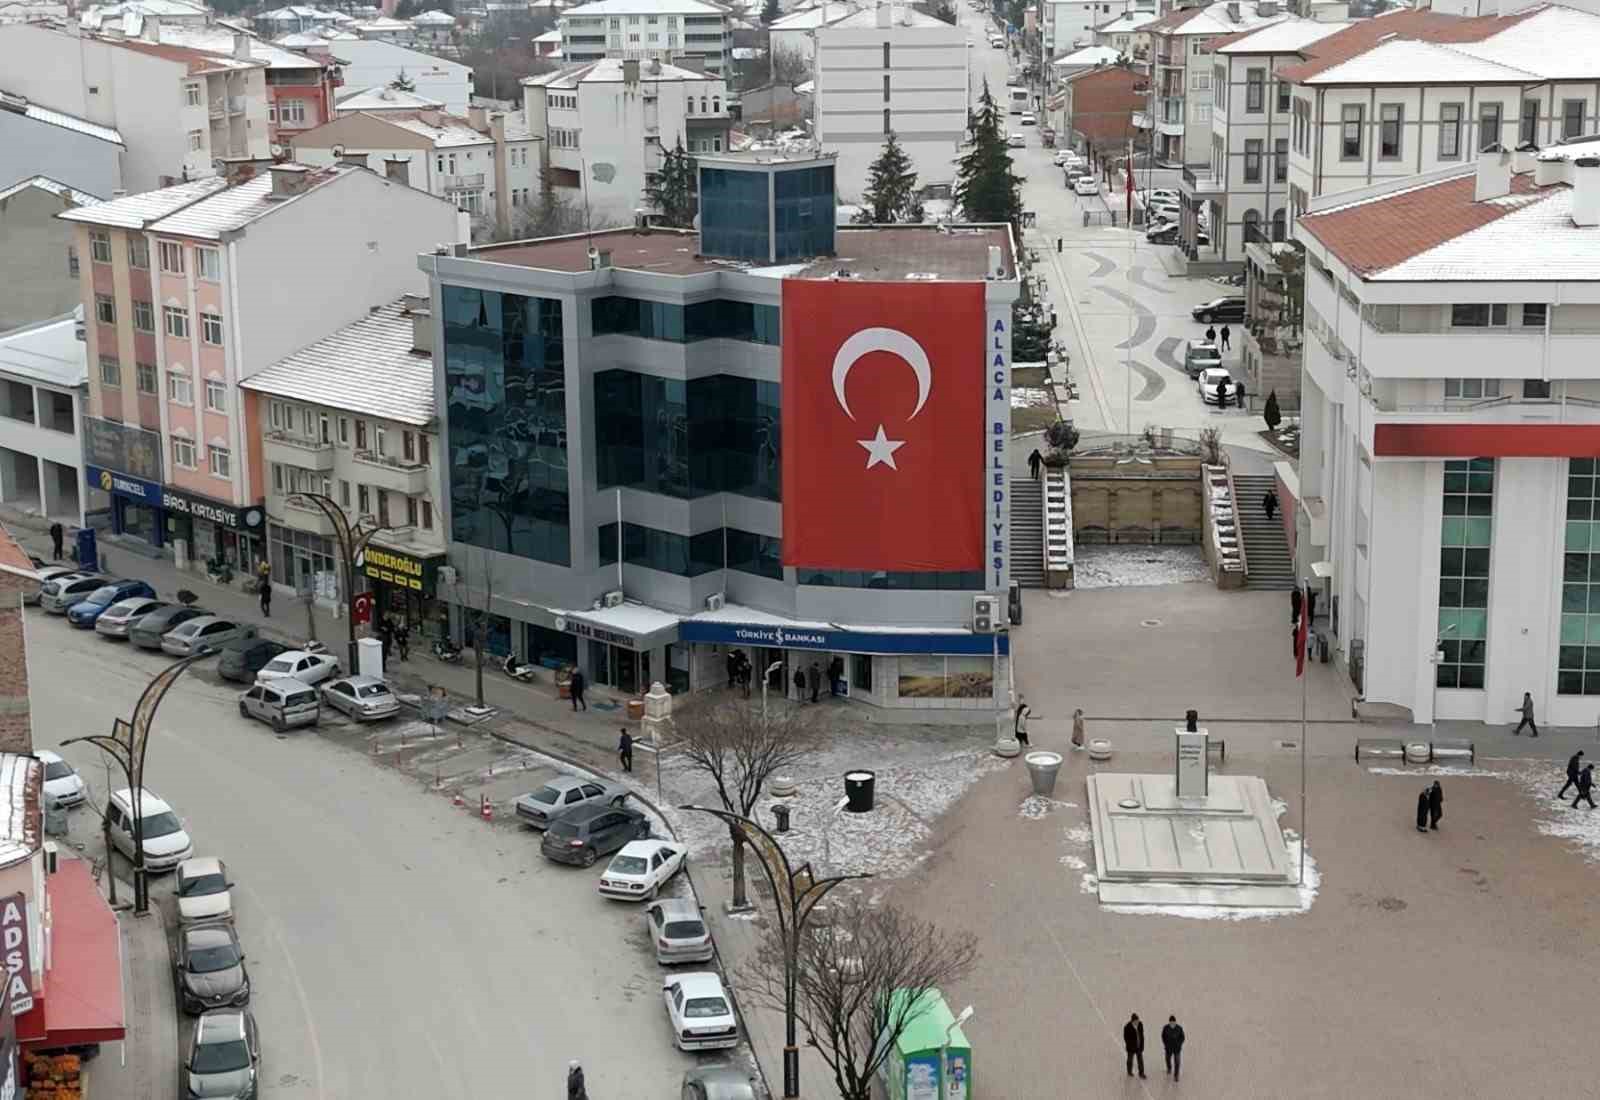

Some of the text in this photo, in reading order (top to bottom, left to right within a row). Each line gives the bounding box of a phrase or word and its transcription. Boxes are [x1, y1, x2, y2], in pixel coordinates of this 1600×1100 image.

[993, 319, 1005, 587] ALACA BELEDİYESİ
[113, 478, 146, 496] TURKCELL
[163, 492, 190, 513] BİROL
[365, 546, 422, 577] ÖNDEROĞLU
[736, 628, 775, 640] TÜRKİYE
[784, 633, 825, 644] BANKASI
[3, 902, 28, 1000] ADSA
